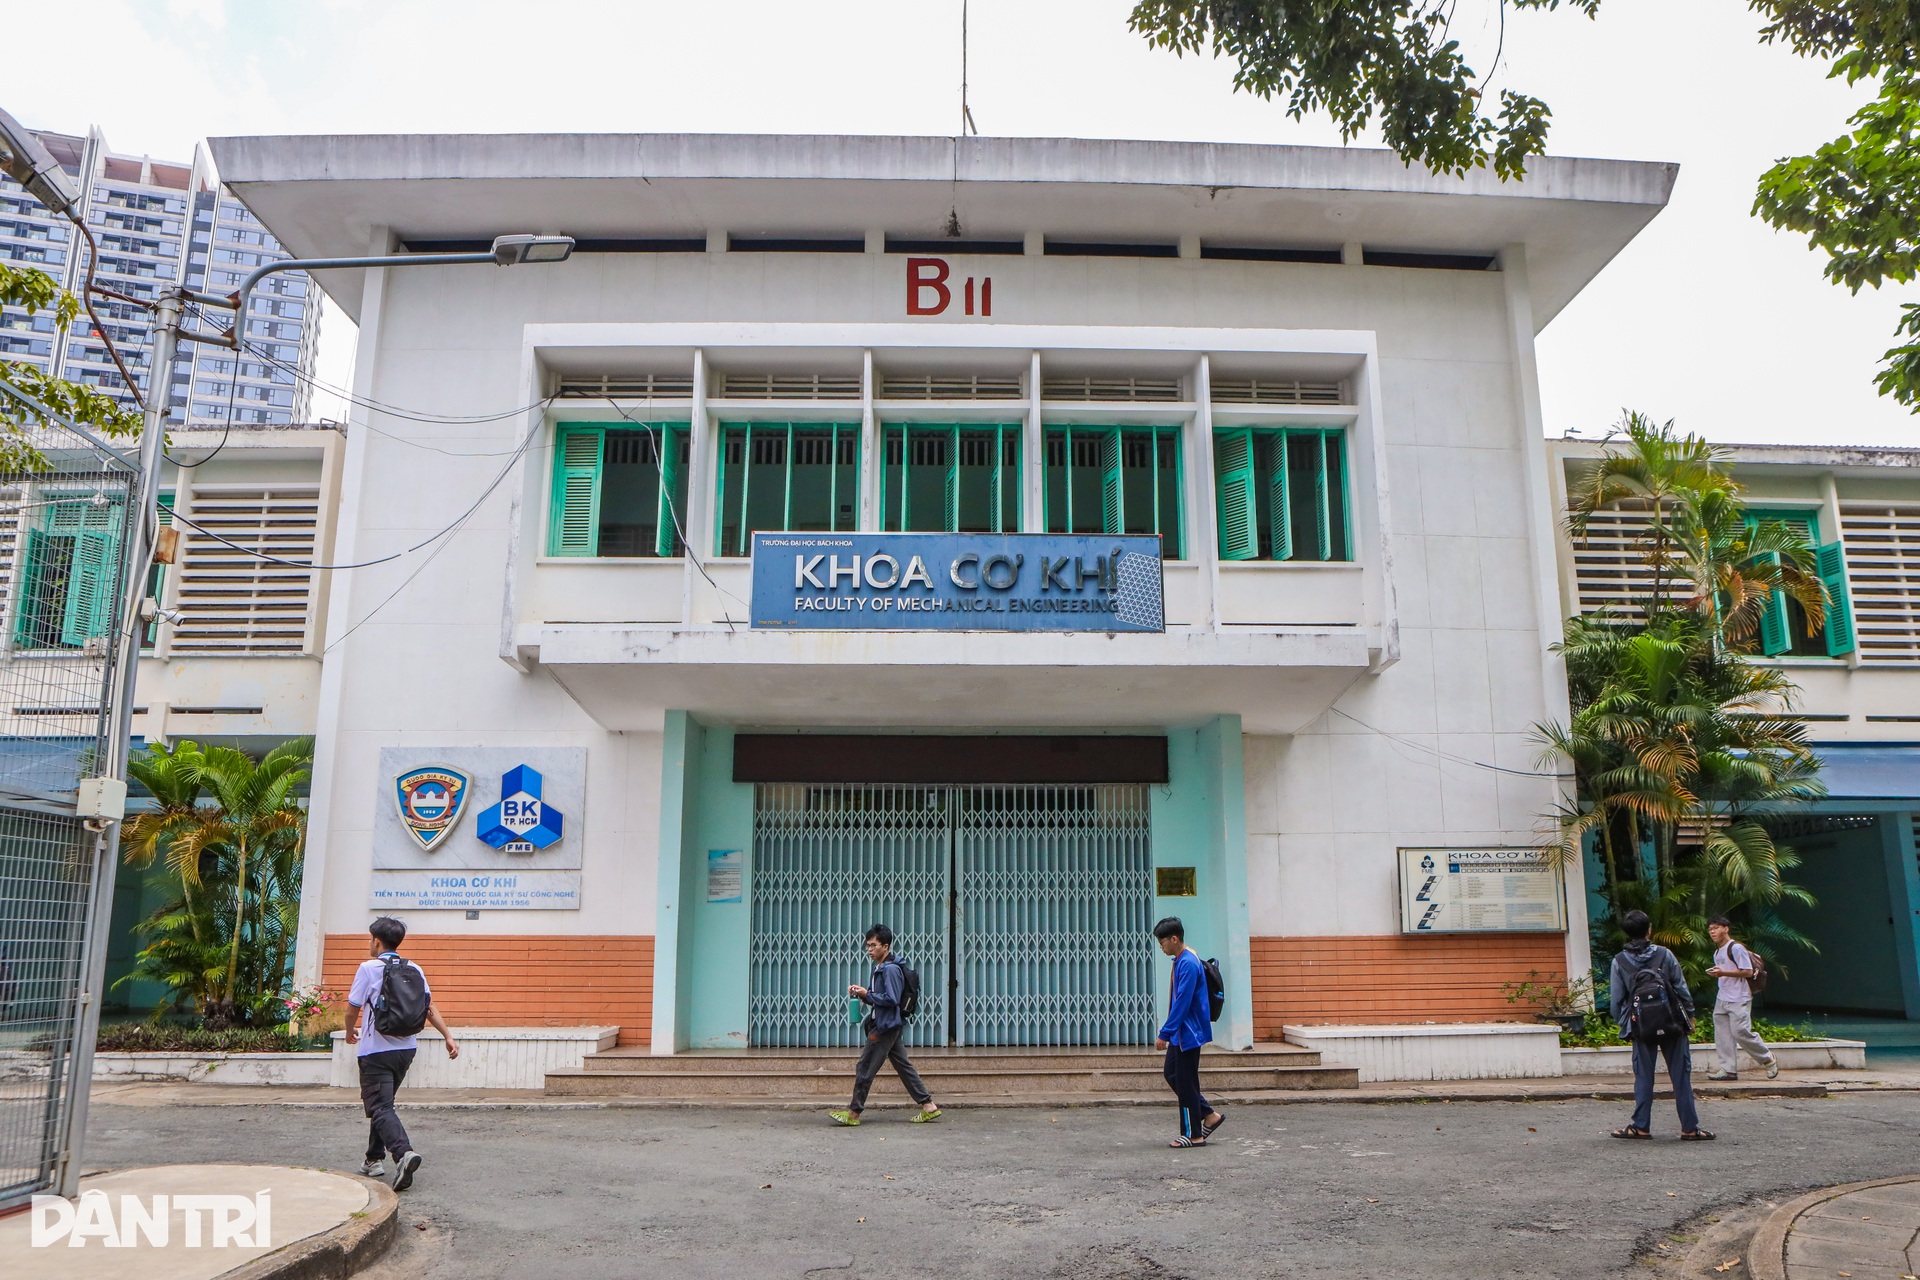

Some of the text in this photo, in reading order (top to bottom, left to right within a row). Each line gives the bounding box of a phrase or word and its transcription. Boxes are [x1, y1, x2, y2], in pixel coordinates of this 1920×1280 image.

[950, 553, 1024, 589] CƠ
[1041, 547, 1122, 590] KHÍ
[795, 597, 1119, 613] FACULTY OF MECHANICAL ENGINEERING
[504, 801, 537, 816] BK
[431, 875, 517, 887] KHOA CƠ KHÍ
